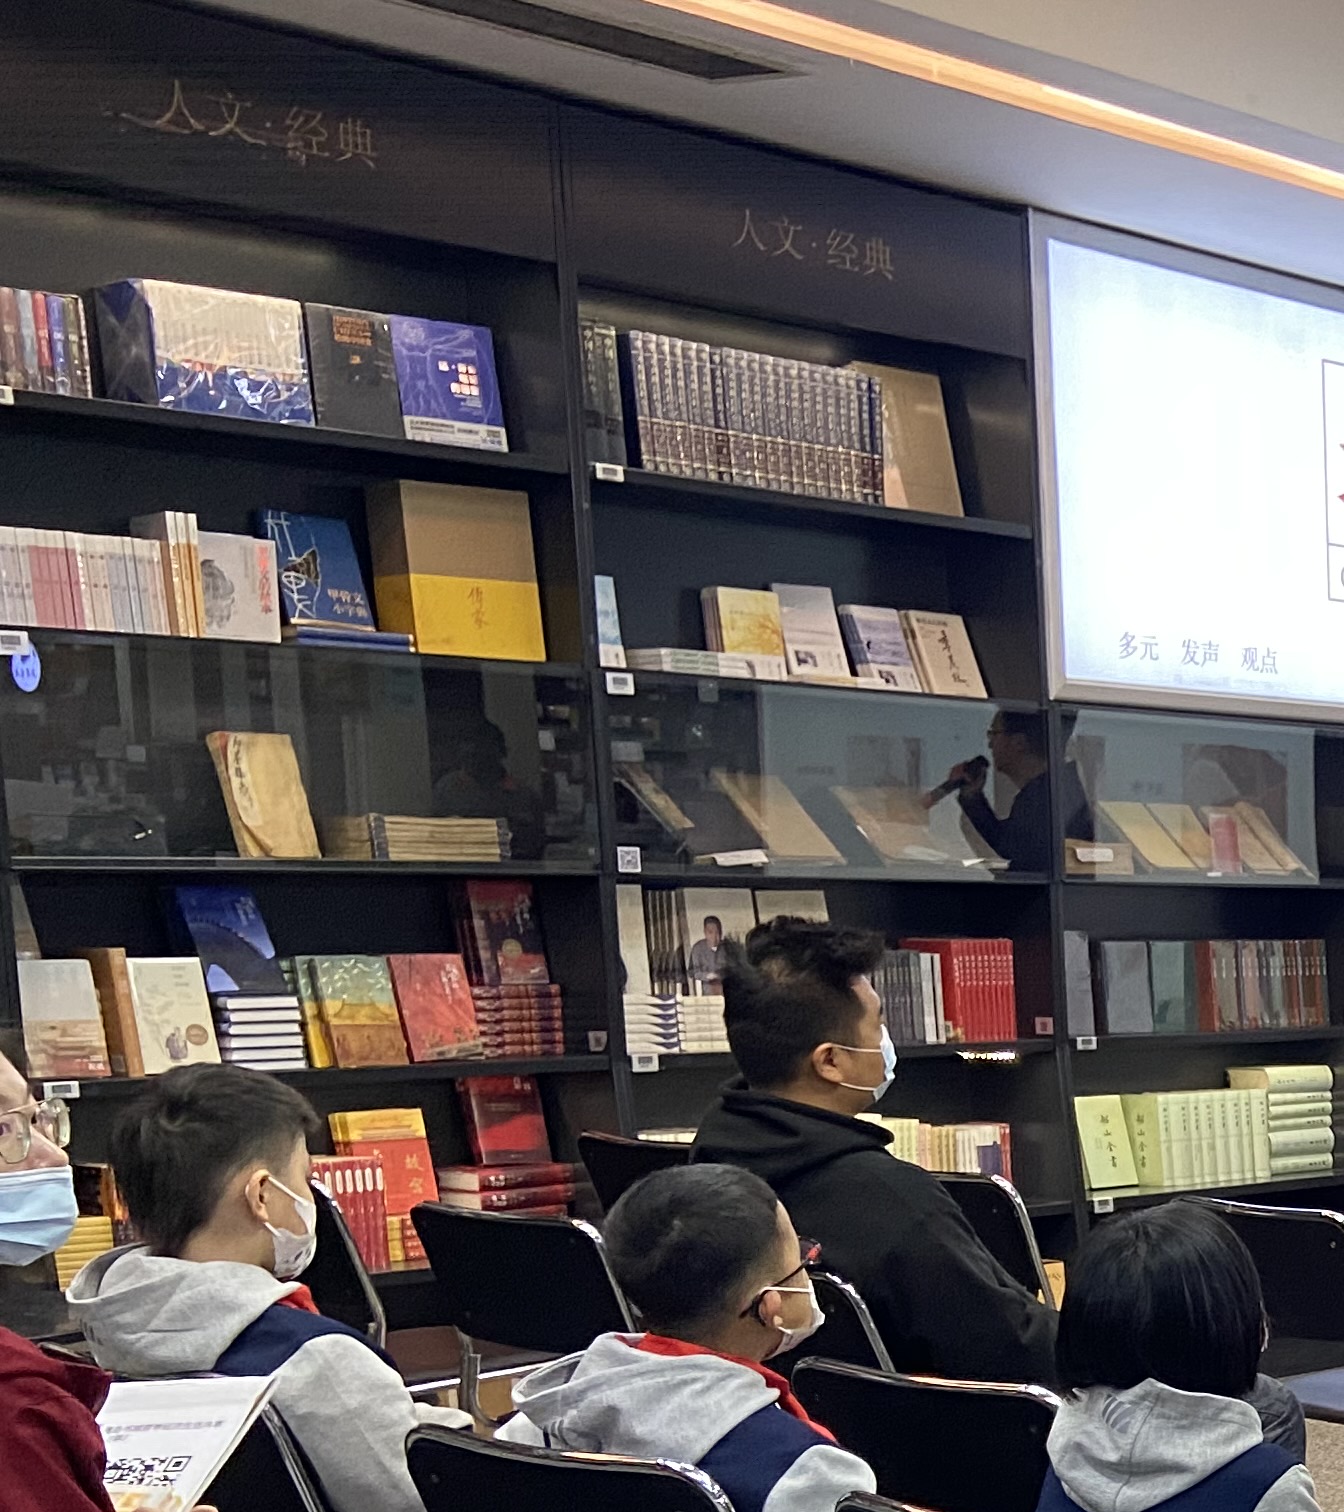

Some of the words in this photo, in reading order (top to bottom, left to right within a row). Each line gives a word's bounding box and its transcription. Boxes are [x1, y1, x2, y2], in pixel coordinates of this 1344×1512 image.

[153, 78, 379, 169] 人文·经典
[731, 208, 895, 280] 人文·经典
[1119, 631, 1159, 662] 多元
[1181, 639, 1219, 667] 发声
[1241, 647, 1279, 674] 观点
